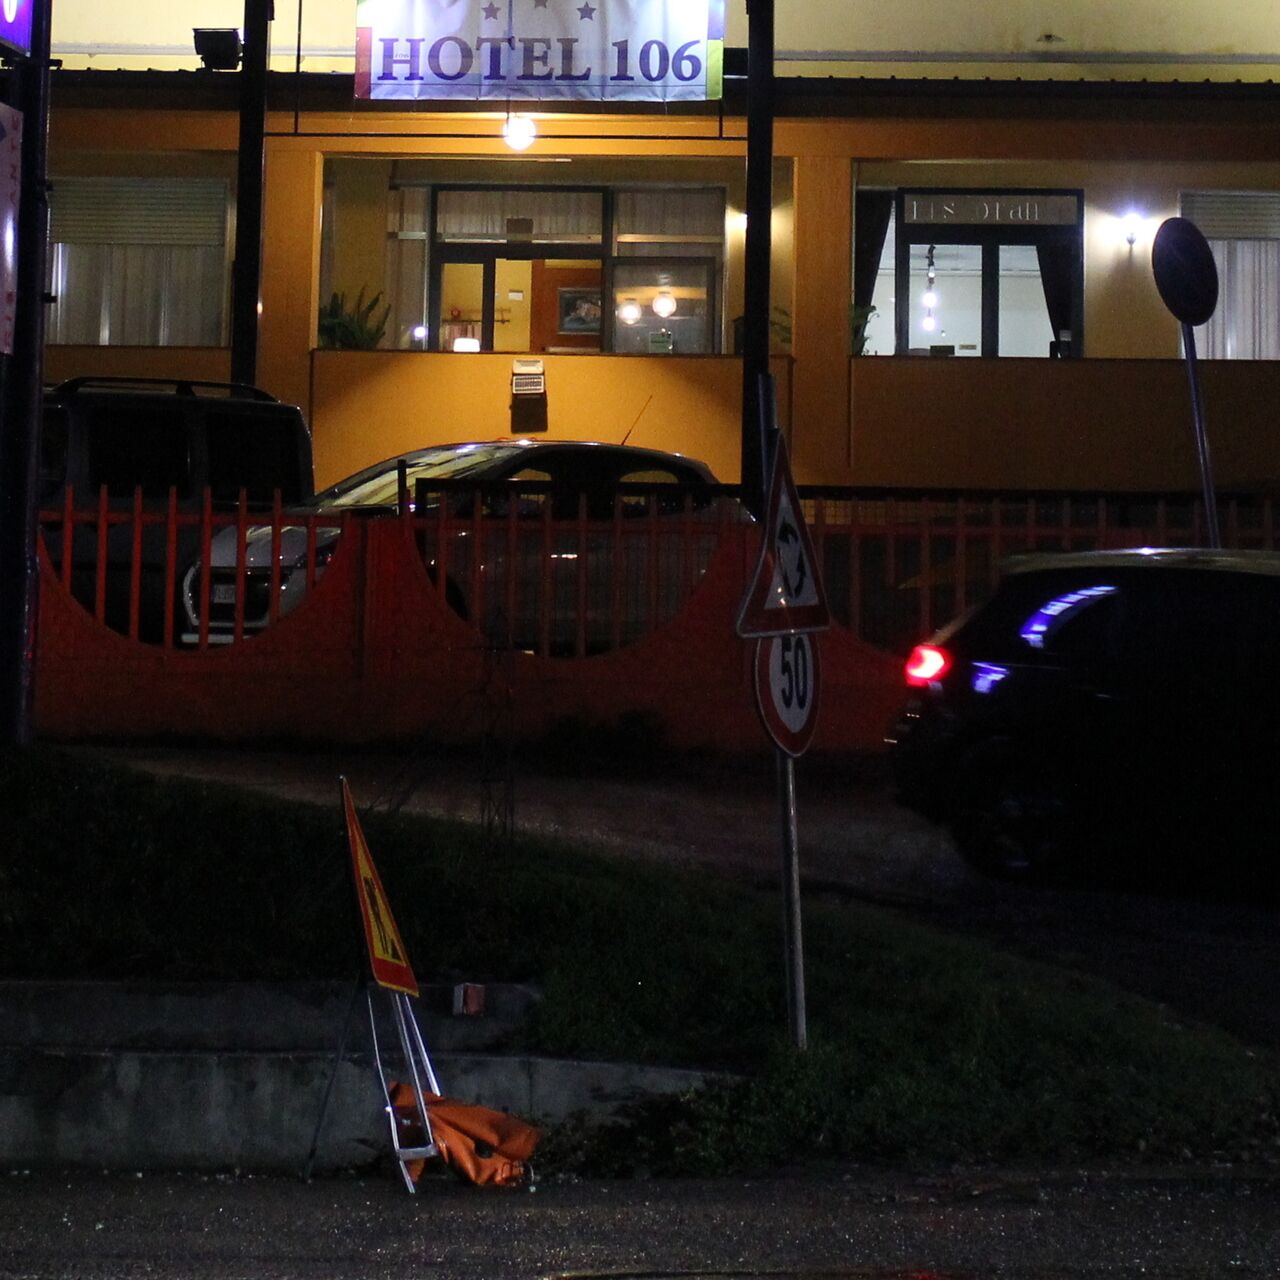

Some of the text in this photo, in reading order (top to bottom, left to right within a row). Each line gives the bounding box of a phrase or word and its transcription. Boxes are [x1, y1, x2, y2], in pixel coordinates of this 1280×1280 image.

[377, 35, 703, 82] HOTEL 106
[780, 635, 808, 710] 50
